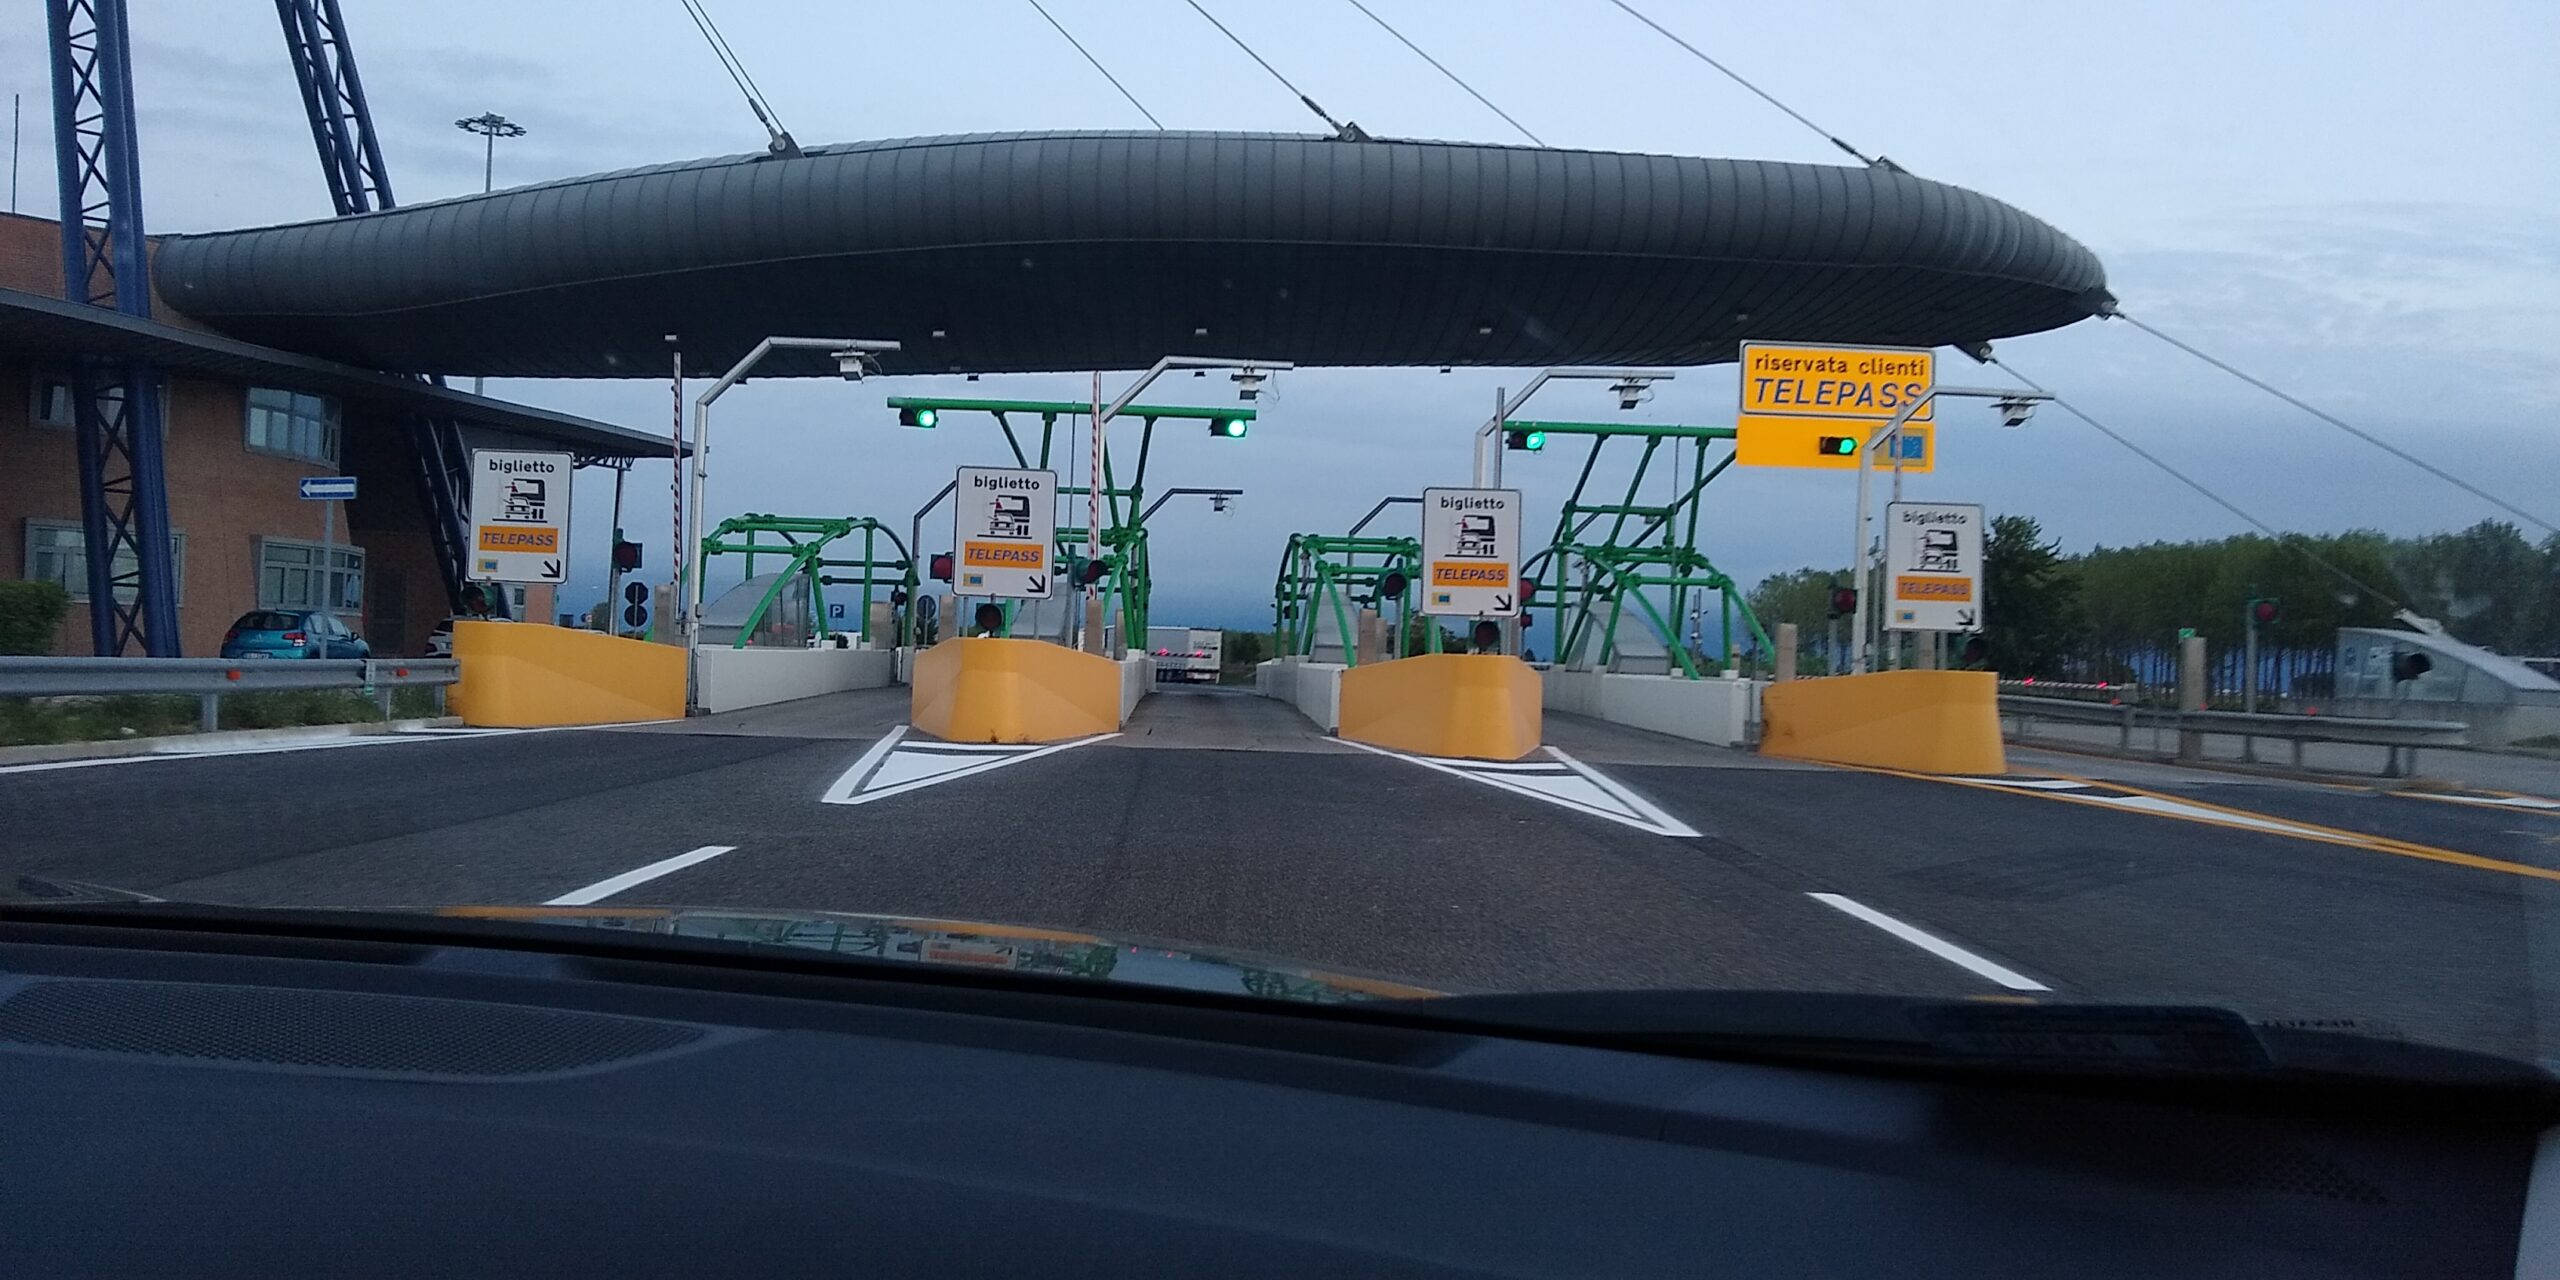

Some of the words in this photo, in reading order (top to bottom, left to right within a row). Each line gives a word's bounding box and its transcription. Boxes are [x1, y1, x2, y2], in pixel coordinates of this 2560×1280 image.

[1755, 354, 1848, 373] riservata
[1859, 358, 1925, 376] clienti
[1755, 378, 1923, 408] TELEPASS
[489, 459, 555, 473] biglietto
[974, 475, 1040, 490] biglietto
[1440, 497, 1505, 510] biglietto
[483, 532, 554, 546] TELEPASS
[969, 548, 1040, 562] TELEPASS
[1436, 568, 1505, 581] TELEPASS
[1901, 582, 1969, 595] TELEPASS
